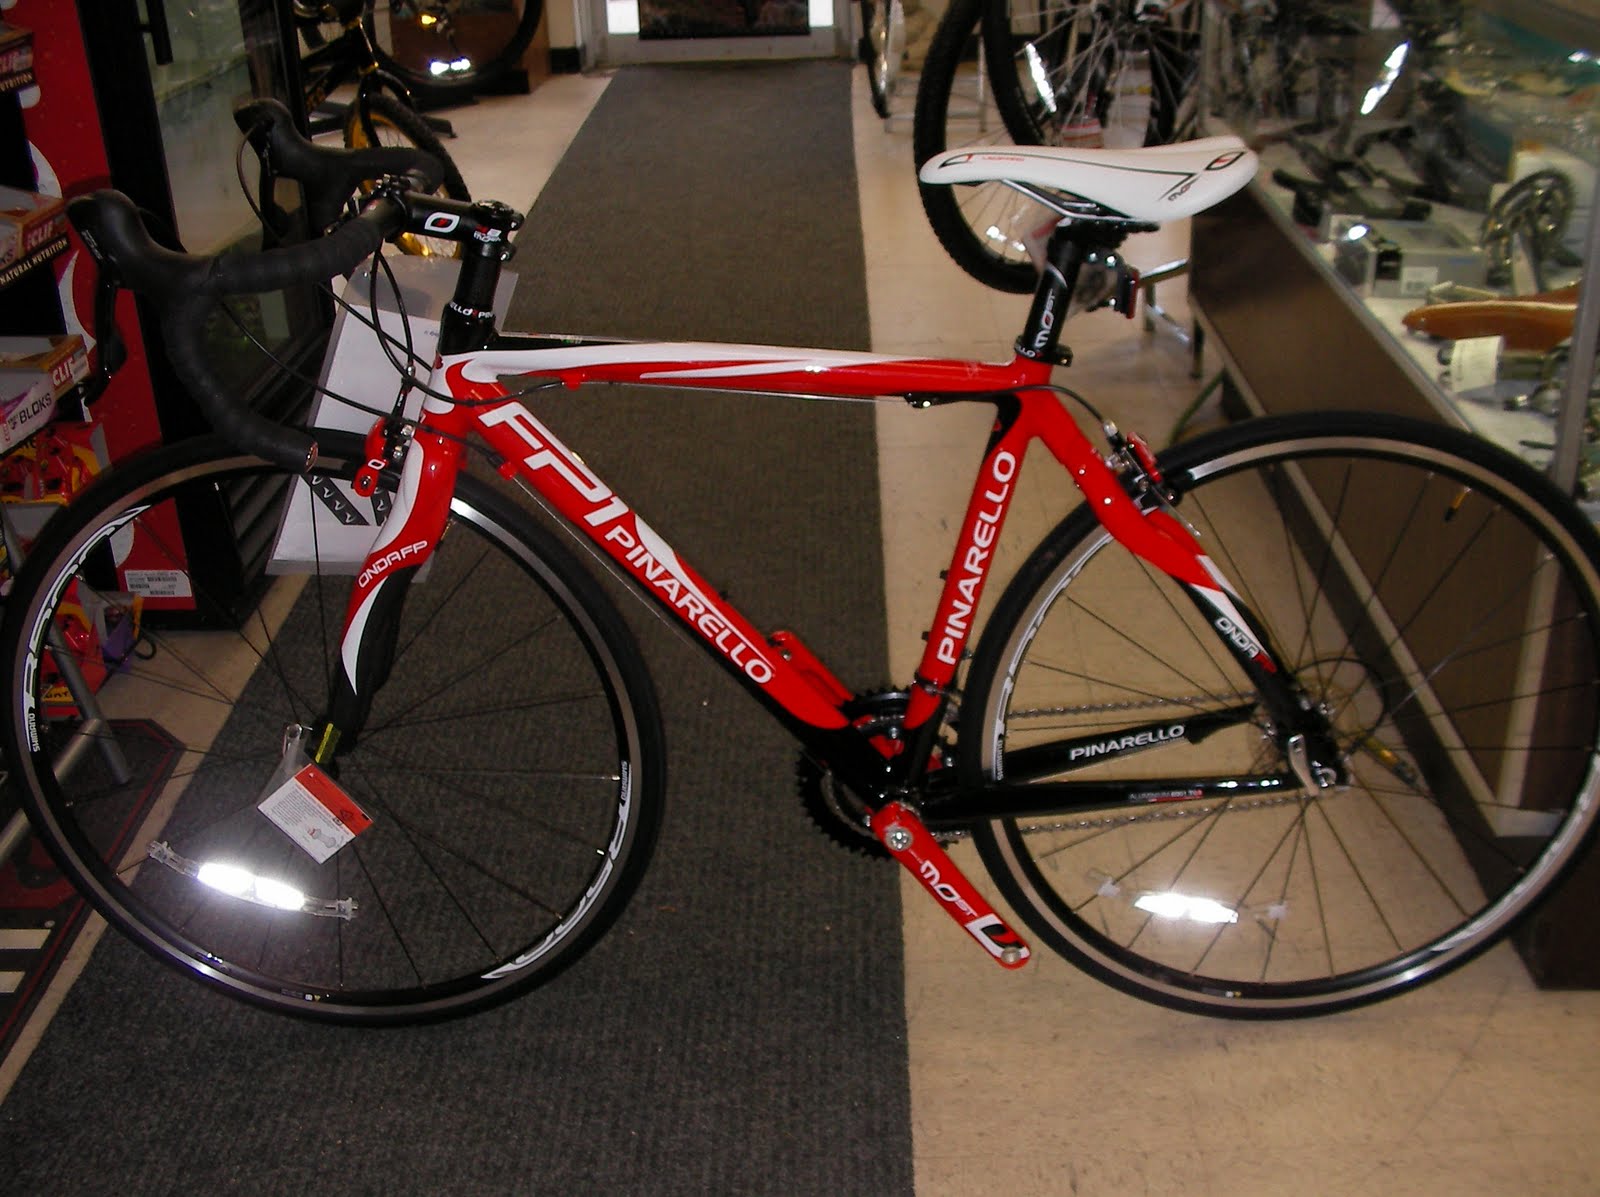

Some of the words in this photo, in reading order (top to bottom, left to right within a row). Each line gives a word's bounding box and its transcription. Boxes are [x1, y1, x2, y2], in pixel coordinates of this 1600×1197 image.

[31, 237, 68, 266] NUTRITION
[19, 392, 52, 425] BLOKS
[937, 450, 1017, 665] PINARELLO
[604, 525, 776, 684] PINARELLO
[1070, 724, 1185, 761] PINARELLO
